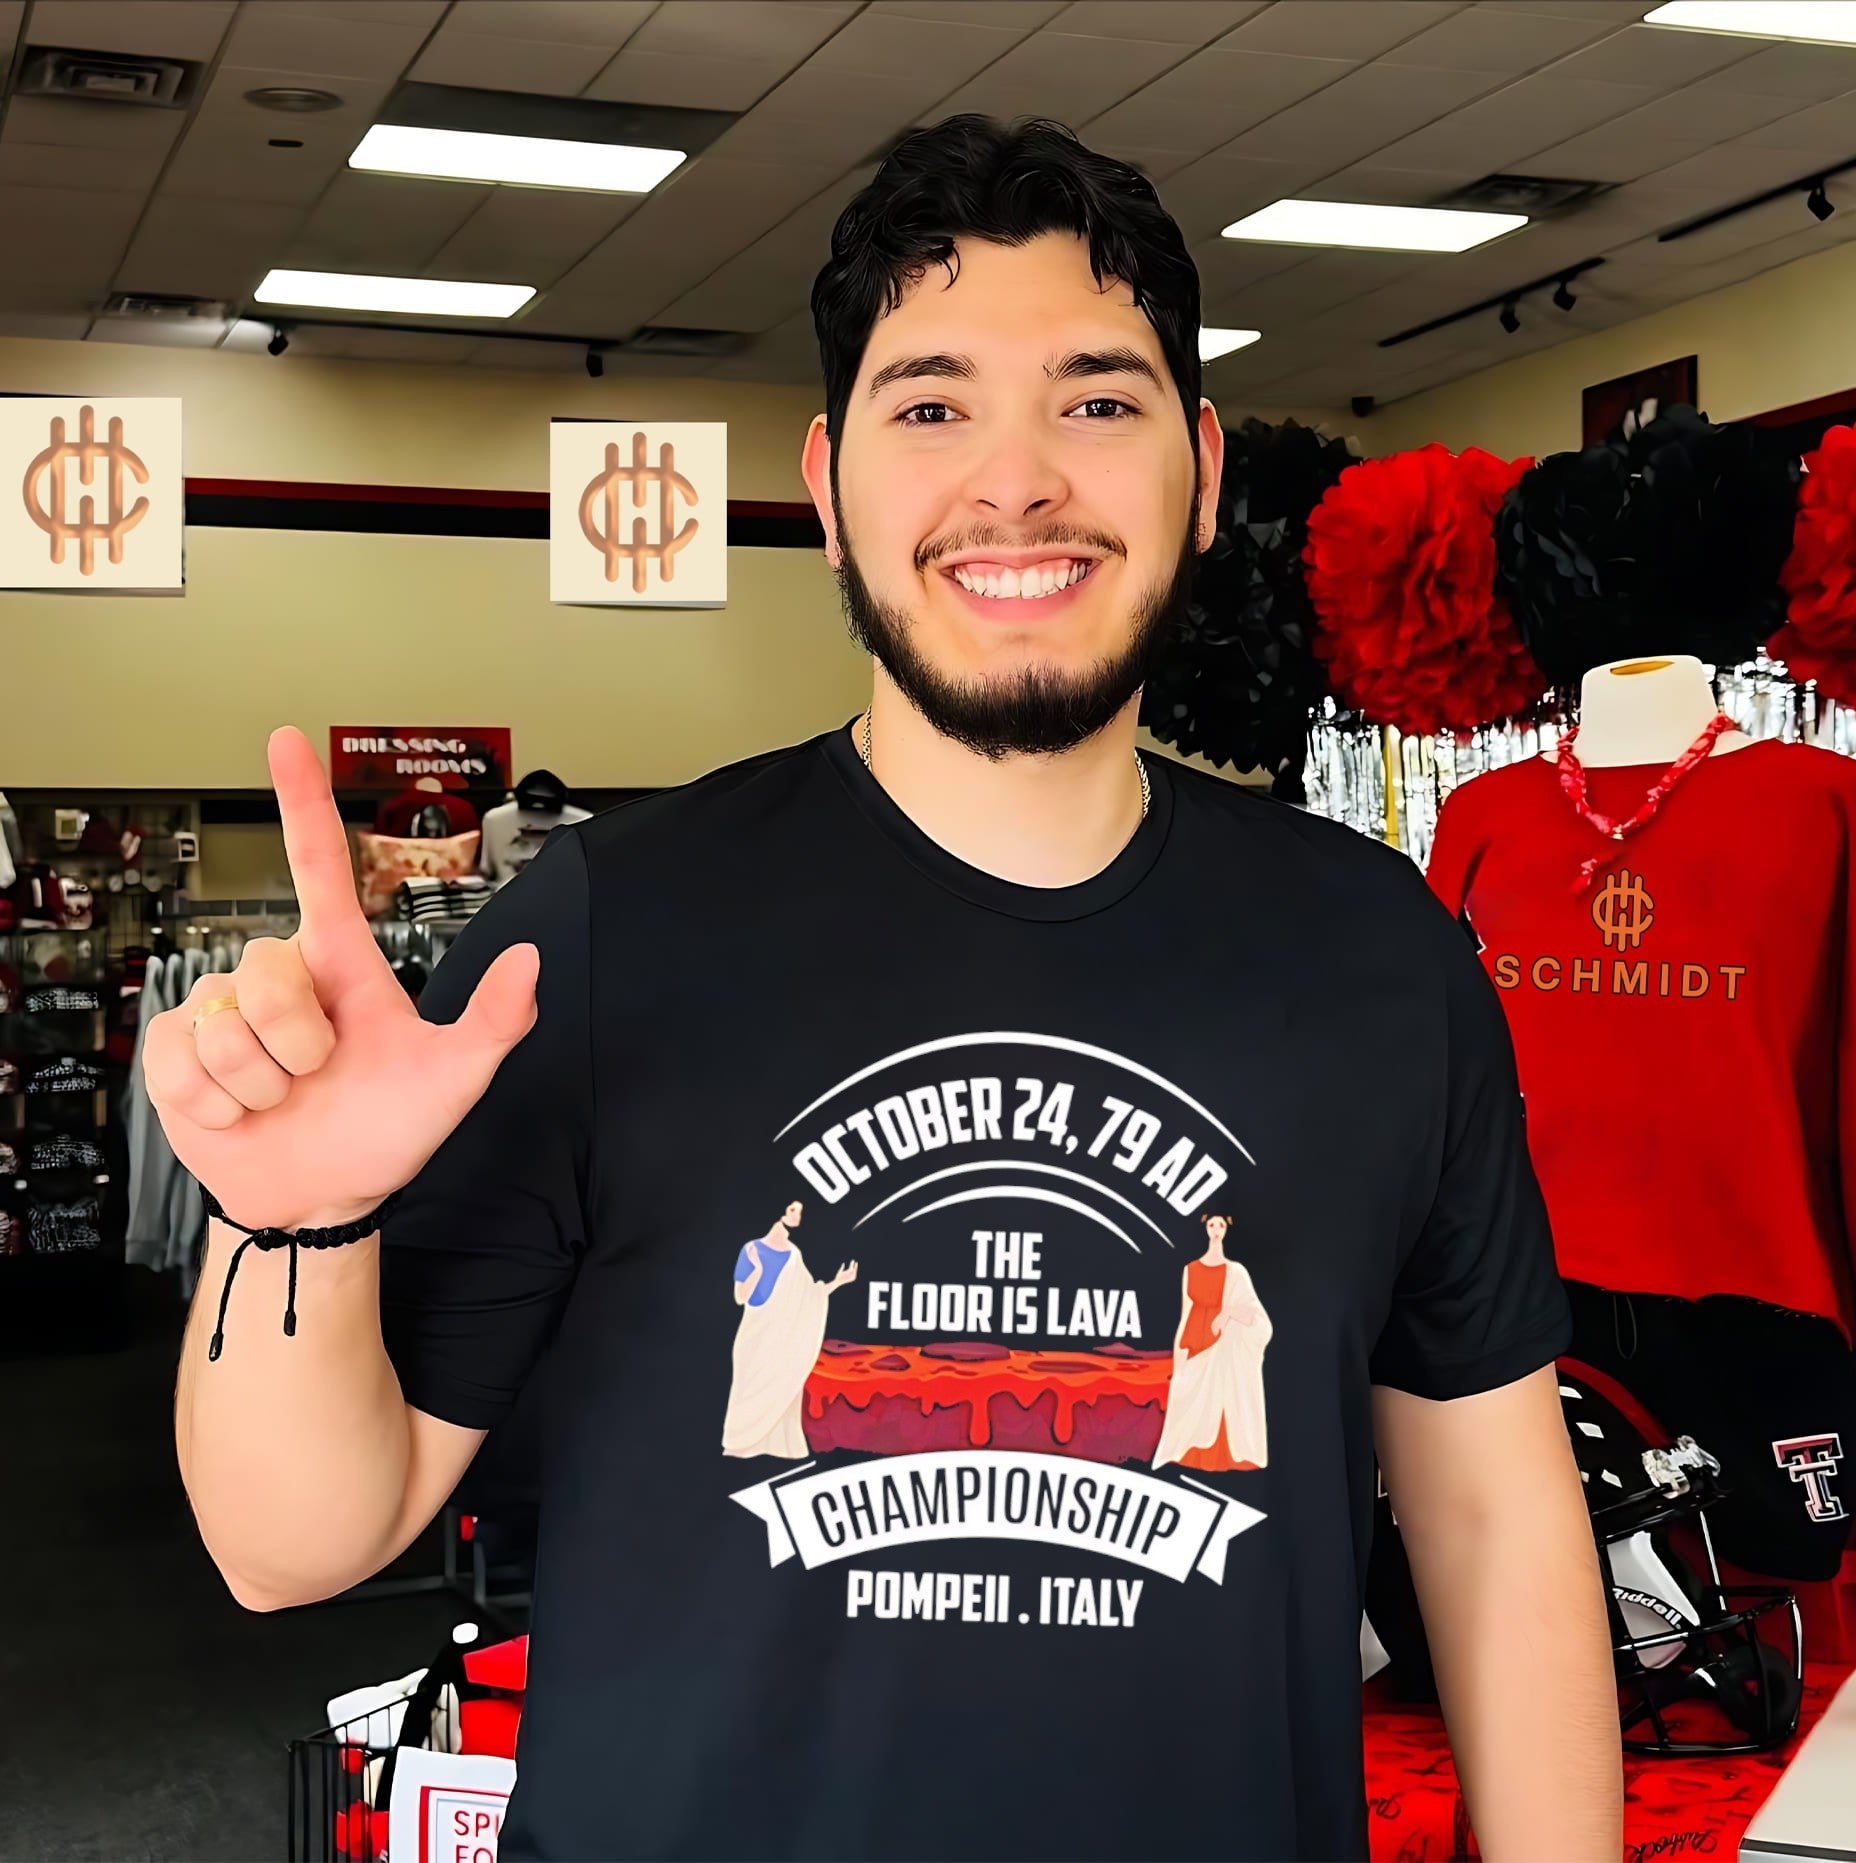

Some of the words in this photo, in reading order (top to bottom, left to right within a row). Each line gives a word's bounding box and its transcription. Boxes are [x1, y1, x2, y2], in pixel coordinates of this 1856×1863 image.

[342, 737, 467, 754] DRESSING
[396, 758, 487, 775] ROOMS
[1494, 953, 1747, 1000] SCHMIDT
[793, 1077, 1002, 1204] OCTOBER
[1013, 1077, 1079, 1155] 24,
[1088, 1095, 1162, 1174] 79
[1142, 1136, 1228, 1217] AD
[972, 1230, 1043, 1281] THE
[867, 1281, 994, 1333] FLOOR
[1002, 1285, 1038, 1335] IS
[1047, 1287, 1143, 1339] LAVA
[811, 1466, 1181, 1555] CHAMPIONSHIP
[846, 1569, 1010, 1623] POMPEII
[1039, 1576, 1144, 1628] ITALY
